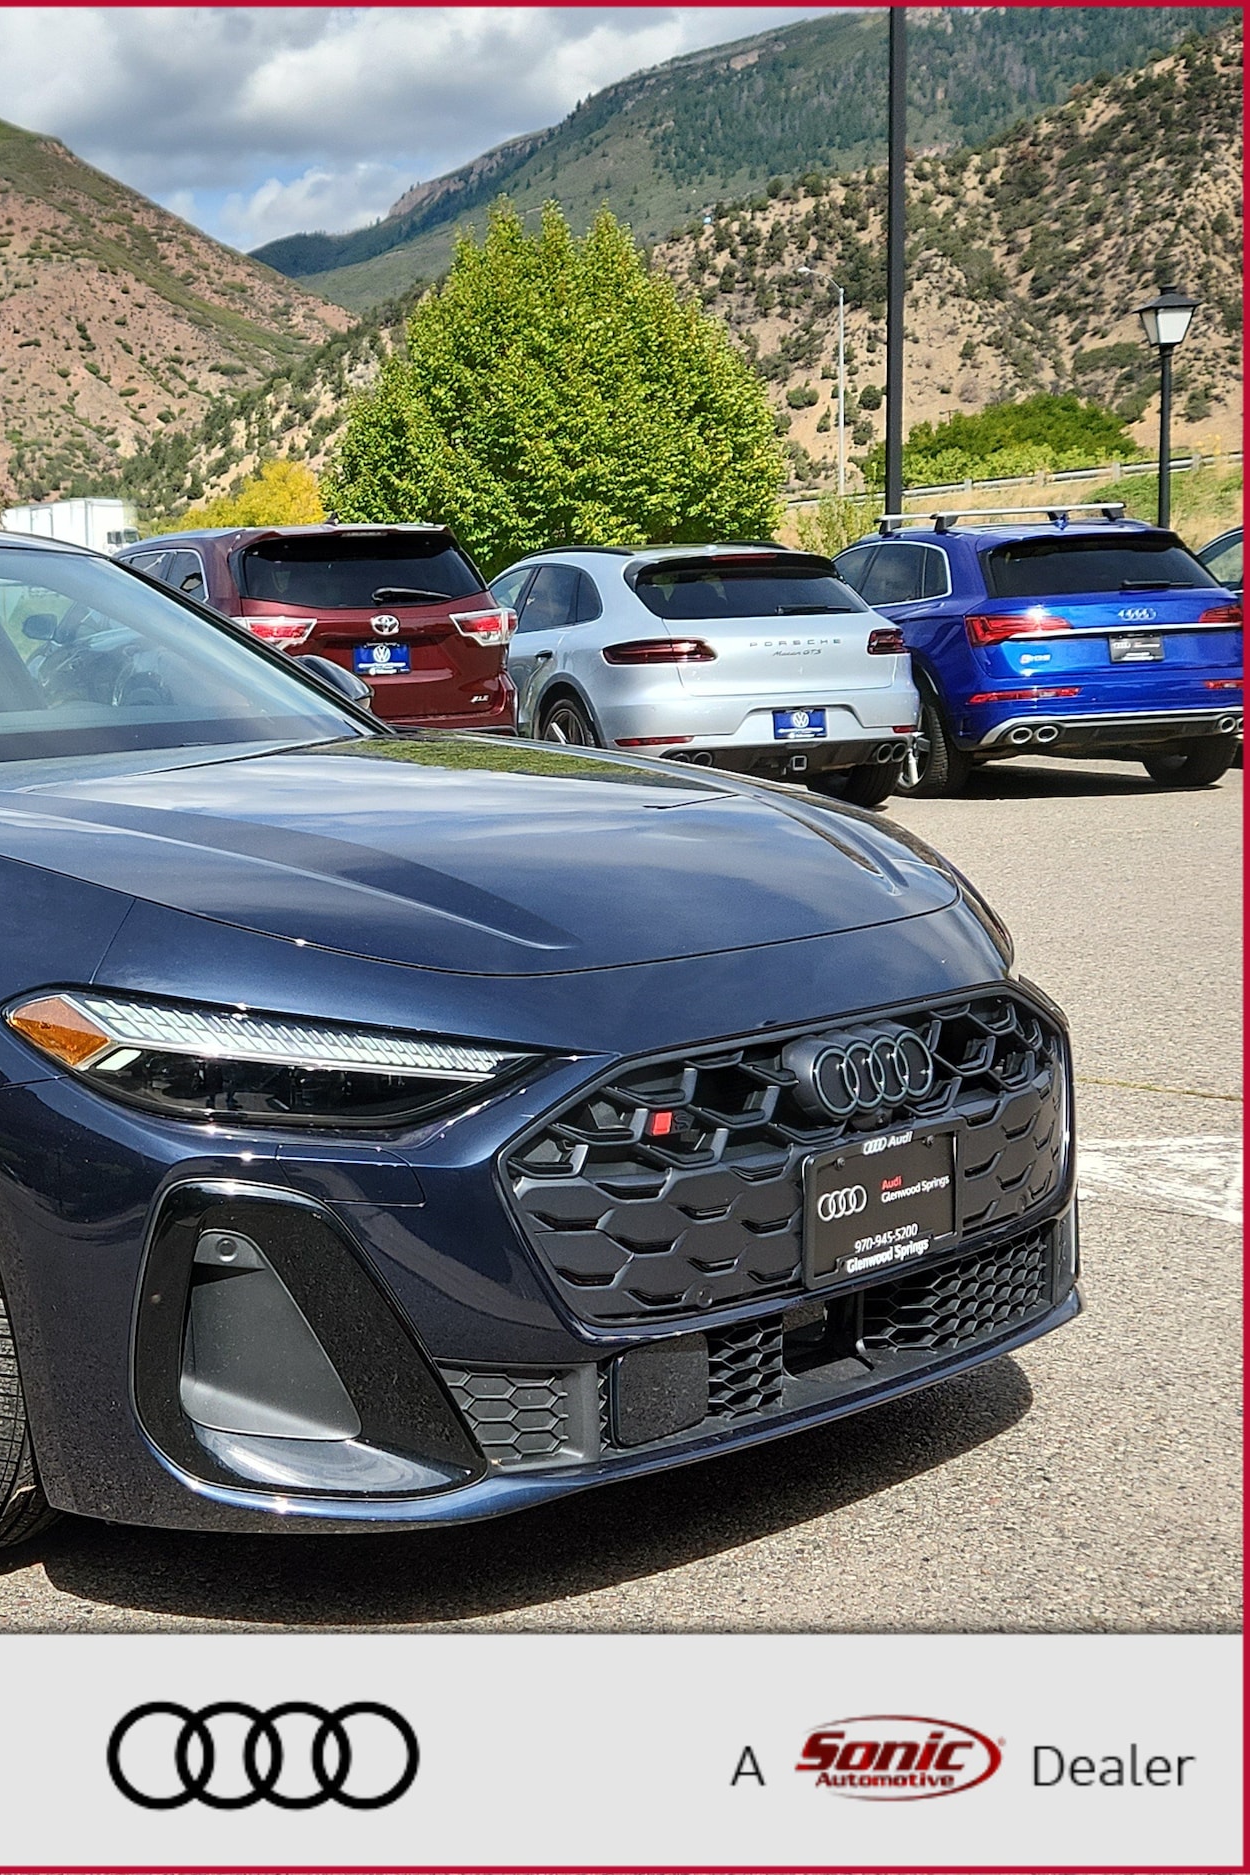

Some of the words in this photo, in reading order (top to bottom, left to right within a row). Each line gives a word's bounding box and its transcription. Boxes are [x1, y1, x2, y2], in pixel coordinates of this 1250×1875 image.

[749, 638, 841, 647] PORSCHE
[802, 648, 822, 656] GTS
[888, 1130, 913, 1148] Audi
[881, 1175, 902, 1190] Audi
[881, 1181, 921, 1203] Glenwood
[921, 1175, 950, 1193] Springs
[854, 1222, 919, 1254] 970-945-5200
[846, 1245, 893, 1273] Glenwood
[894, 1238, 929, 1260] Springs
